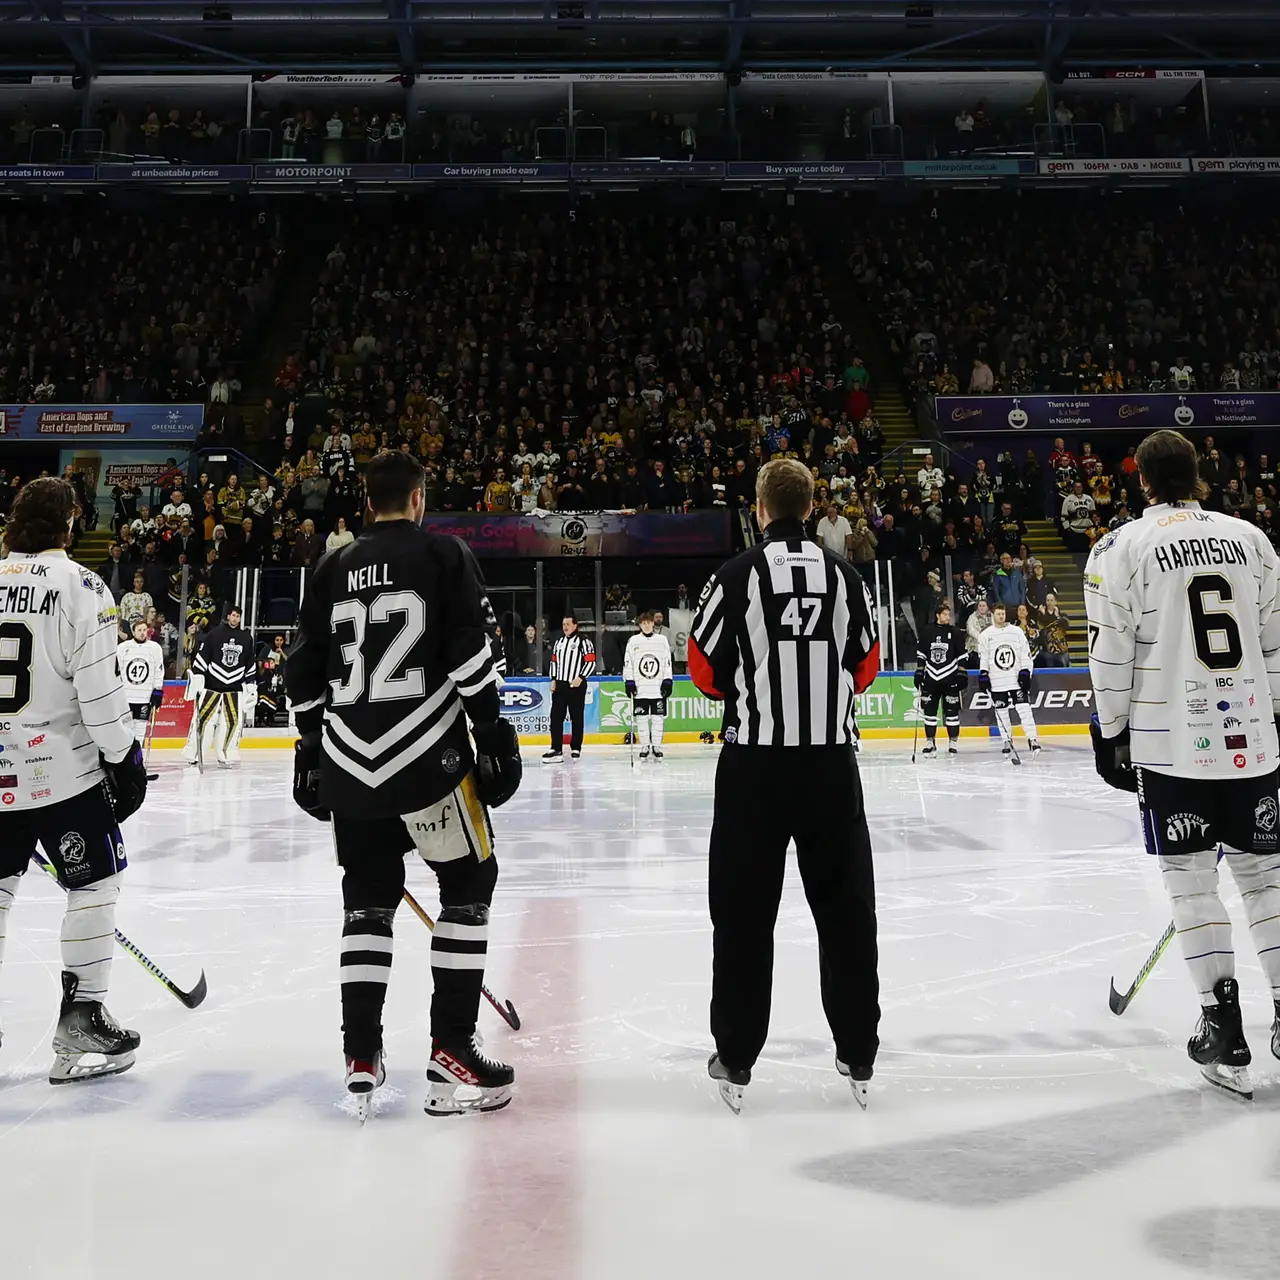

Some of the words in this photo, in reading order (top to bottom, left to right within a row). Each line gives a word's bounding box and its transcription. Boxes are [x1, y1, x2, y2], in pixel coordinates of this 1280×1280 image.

[766, 165, 783, 174] Buy
[819, 165, 844, 174] today
[925, 163, 997, 173] motorpoint.co.uk
[1047, 161, 1074, 172] gem
[1084, 162, 1110, 170] 106FM
[1121, 162, 1139, 170] DAB
[1150, 161, 1182, 169] MOBILE
[1198, 159, 1224, 170] gem
[1229, 159, 1265, 170] playing
[8, 169, 31, 177] seats
[33, 169, 41, 177] in
[43, 169, 64, 177] town
[142, 169, 190, 177] unbeatable
[192, 169, 218, 178] prices
[276, 167, 352, 176] MOTORPOINT
[444, 167, 459, 175] Car
[461, 167, 491, 177] buying
[492, 167, 516, 175] made
[518, 168, 538, 176] easy
[258, 212, 266, 224] 6
[570, 210, 577, 221] 5
[930, 208, 938, 220] 4
[41, 413, 68, 422] American
[70, 413, 90, 422] Hops
[92, 412, 108, 421] and
[1056, 417, 1091, 425] Nottingham
[40, 423, 55, 433] East
[56, 423, 63, 432] of
[64, 423, 93, 433] England
[94, 423, 125, 433] Brewing
[109, 465, 141, 475] American
[1155, 538, 1247, 572] HARRISON
[347, 563, 393, 592] NEILL
[781, 598, 822, 636] 47
[1185, 572, 1243, 672] 6
[330, 590, 426, 706] 32
[999, 651, 1011, 664] 47
[131, 665, 145, 678] 47
[643, 661, 654, 672] 47
[1215, 678, 1233, 687] IBC
[27, 734, 46, 748] DSP
[25, 756, 52, 764] stubhero
[415, 804, 451, 832] mf
[1167, 812, 1204, 823] DIZZYFISH
[1253, 832, 1278, 840] LYONS
[64, 862, 90, 875] LYONS
[434, 1050, 479, 1086] CCM
